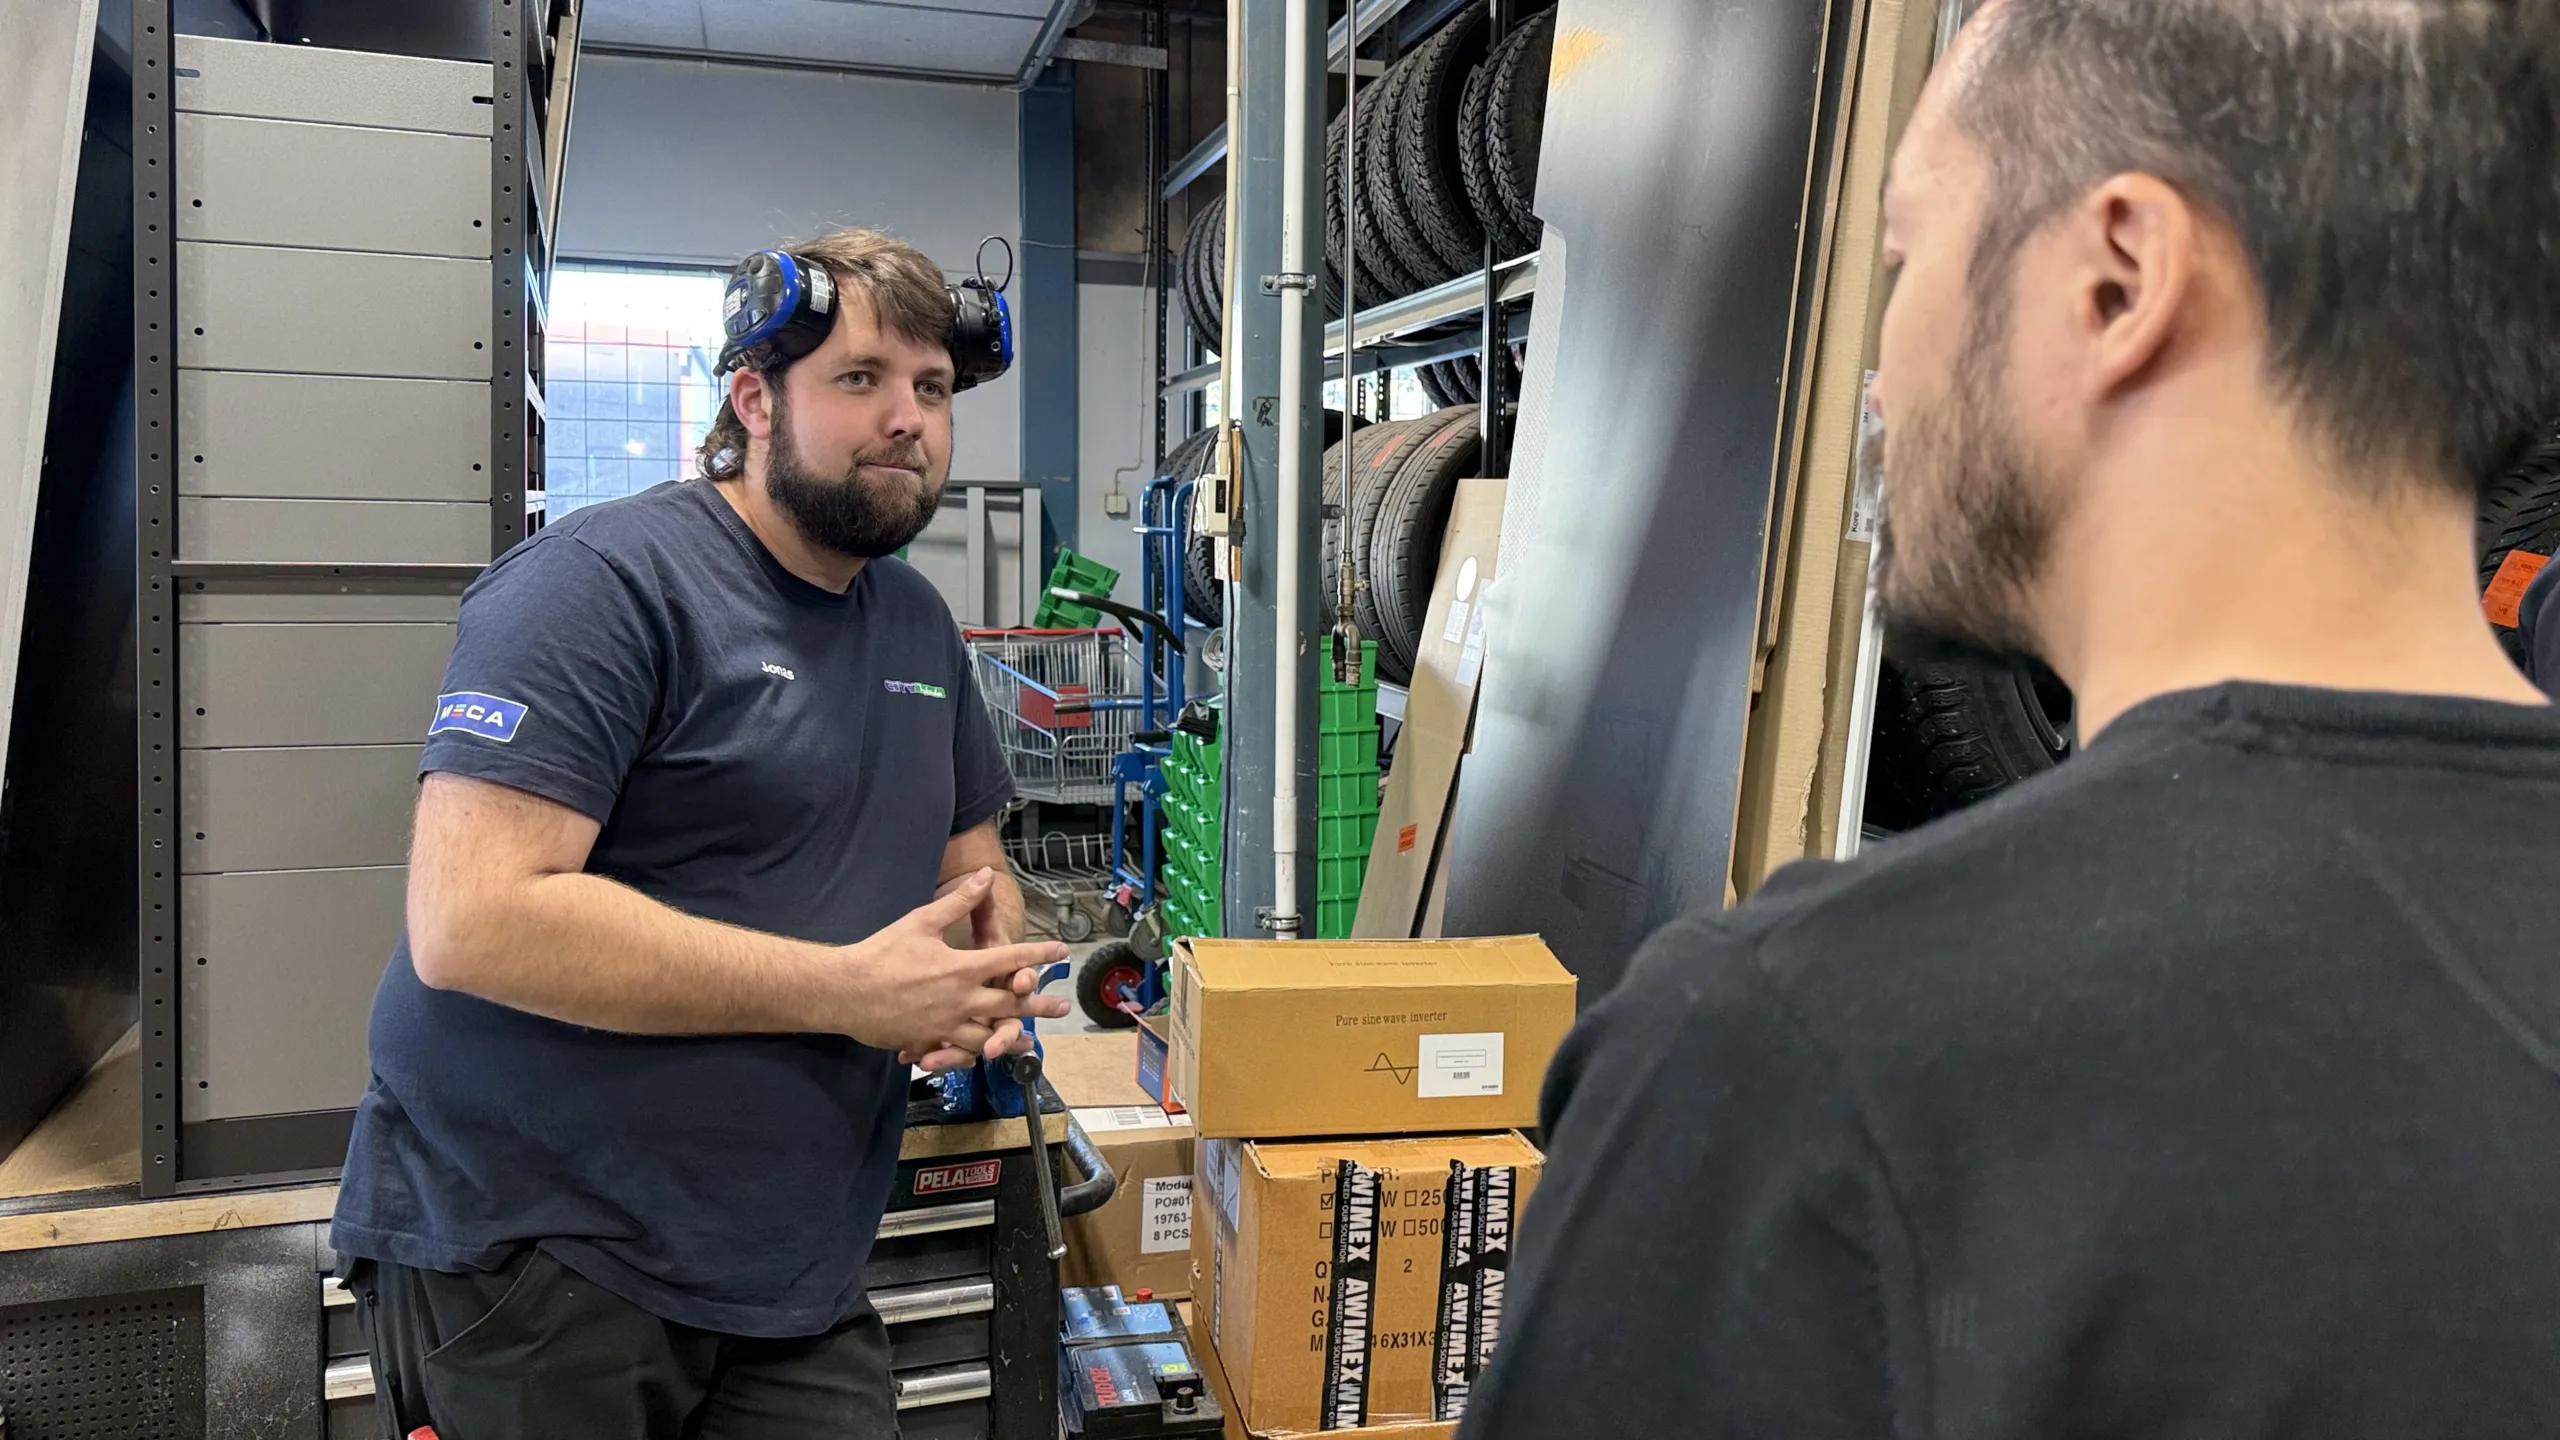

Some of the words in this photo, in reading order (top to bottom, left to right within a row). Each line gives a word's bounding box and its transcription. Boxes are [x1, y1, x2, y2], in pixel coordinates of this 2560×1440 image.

[761, 661, 795, 680] Jonas
[440, 704, 503, 727] MECA
[1335, 1014, 1358, 1027] Pure
[1362, 1012, 1381, 1025] sine
[1383, 1013, 1407, 1024] wave
[1410, 1011, 1448, 1023] inverter
[919, 1168, 965, 1190] PELA
[965, 1164, 995, 1176] TOOLS
[1453, 1162, 1462, 1183] YOUR
[1479, 1170, 1487, 1192] NEED
[1342, 1178, 1351, 1200] NEED
[1452, 1184, 1461, 1205] NEED
[1341, 1204, 1349, 1223] OUR
[1478, 1197, 1486, 1214] OUR
[1451, 1210, 1459, 1228] OUR
[1153, 1231, 1160, 1241] 8
[1339, 1223, 1349, 1264] SOLUTION
[1477, 1215, 1486, 1254] SOLUTION
[1448, 1228, 1458, 1268] SOLUTION
[1403, 1258, 1412, 1273] 2
[1337, 1277, 1345, 1300] YOUR
[1475, 1268, 1483, 1290] YOUR
[1445, 1282, 1453, 1304] YOUR
[1474, 1291, 1482, 1312] NEED
[1335, 1301, 1344, 1322] NEED
[1443, 1305, 1451, 1326] NEED
[1334, 1327, 1342, 1345] OUR
[1340, 1277, 1369, 1383] AWIMEX
[1440, 1331, 1449, 1348] OUR
[1445, 1282, 1469, 1385] AWIMEX
[1331, 1345, 1341, 1385] SOLUTION
[1329, 1386, 1338, 1407] NEED
